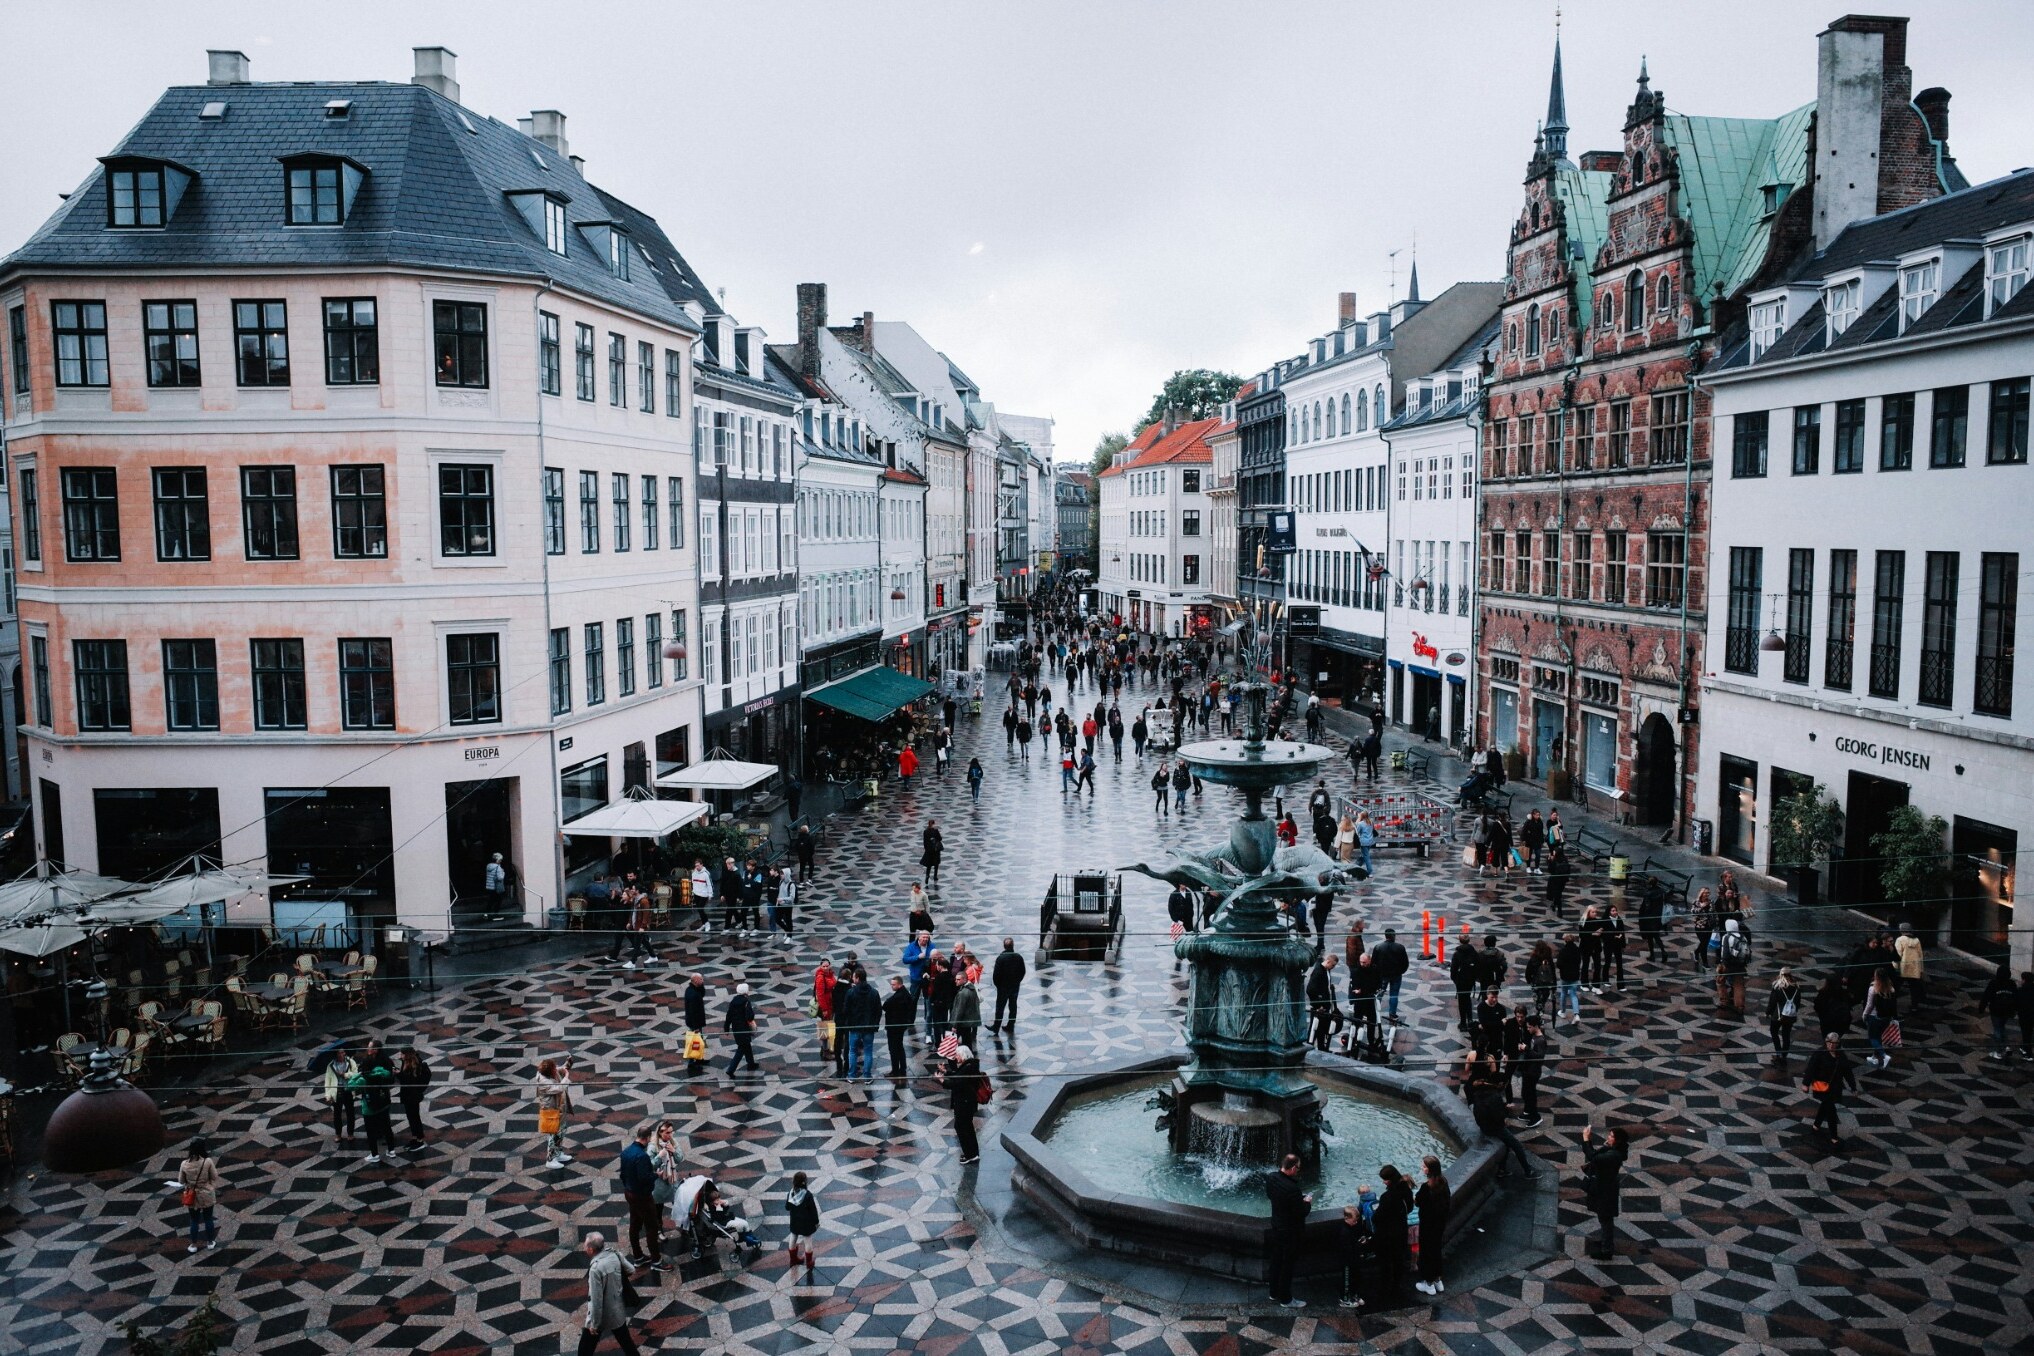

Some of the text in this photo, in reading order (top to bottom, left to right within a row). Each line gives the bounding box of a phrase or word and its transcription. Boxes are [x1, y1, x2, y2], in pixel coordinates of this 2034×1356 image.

[464, 747, 500, 760] EUROPA
[1835, 736, 1930, 771] GEORG JENSEN
